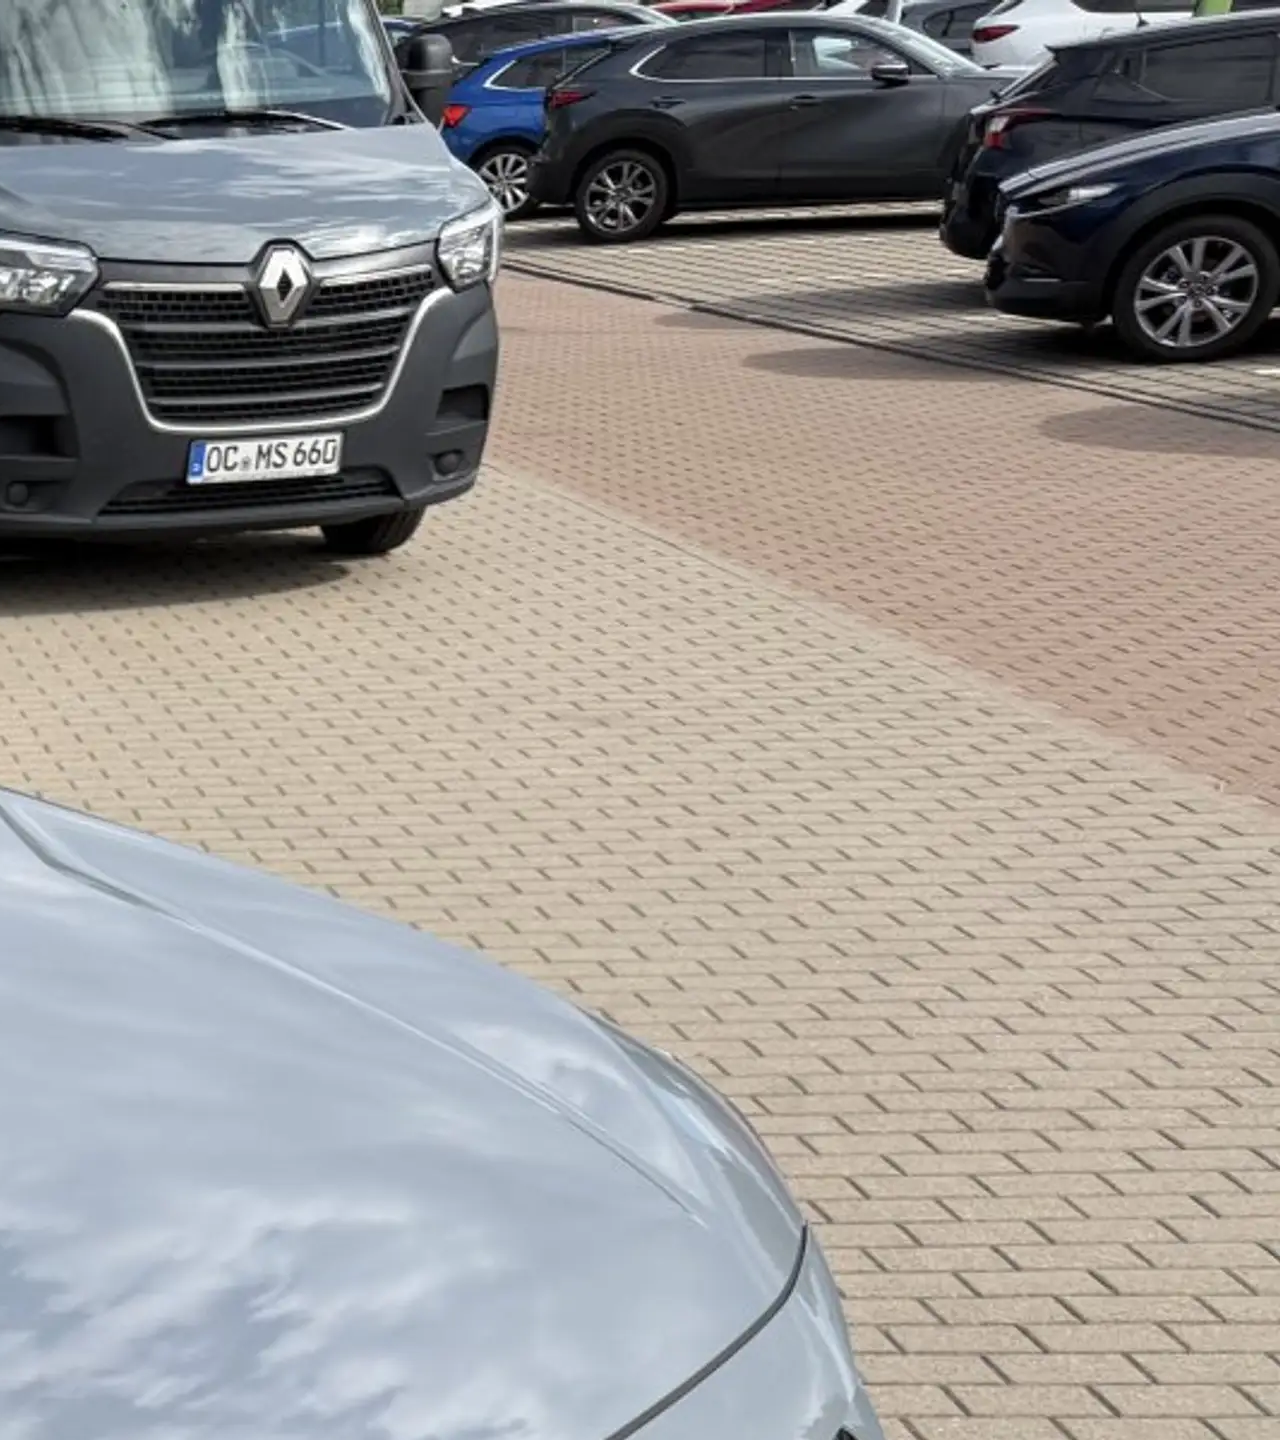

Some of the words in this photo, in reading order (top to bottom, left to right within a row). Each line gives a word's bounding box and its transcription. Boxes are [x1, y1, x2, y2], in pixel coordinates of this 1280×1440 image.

[206, 446, 239, 472] OC
[255, 442, 289, 470] MS
[293, 438, 337, 467] 660
